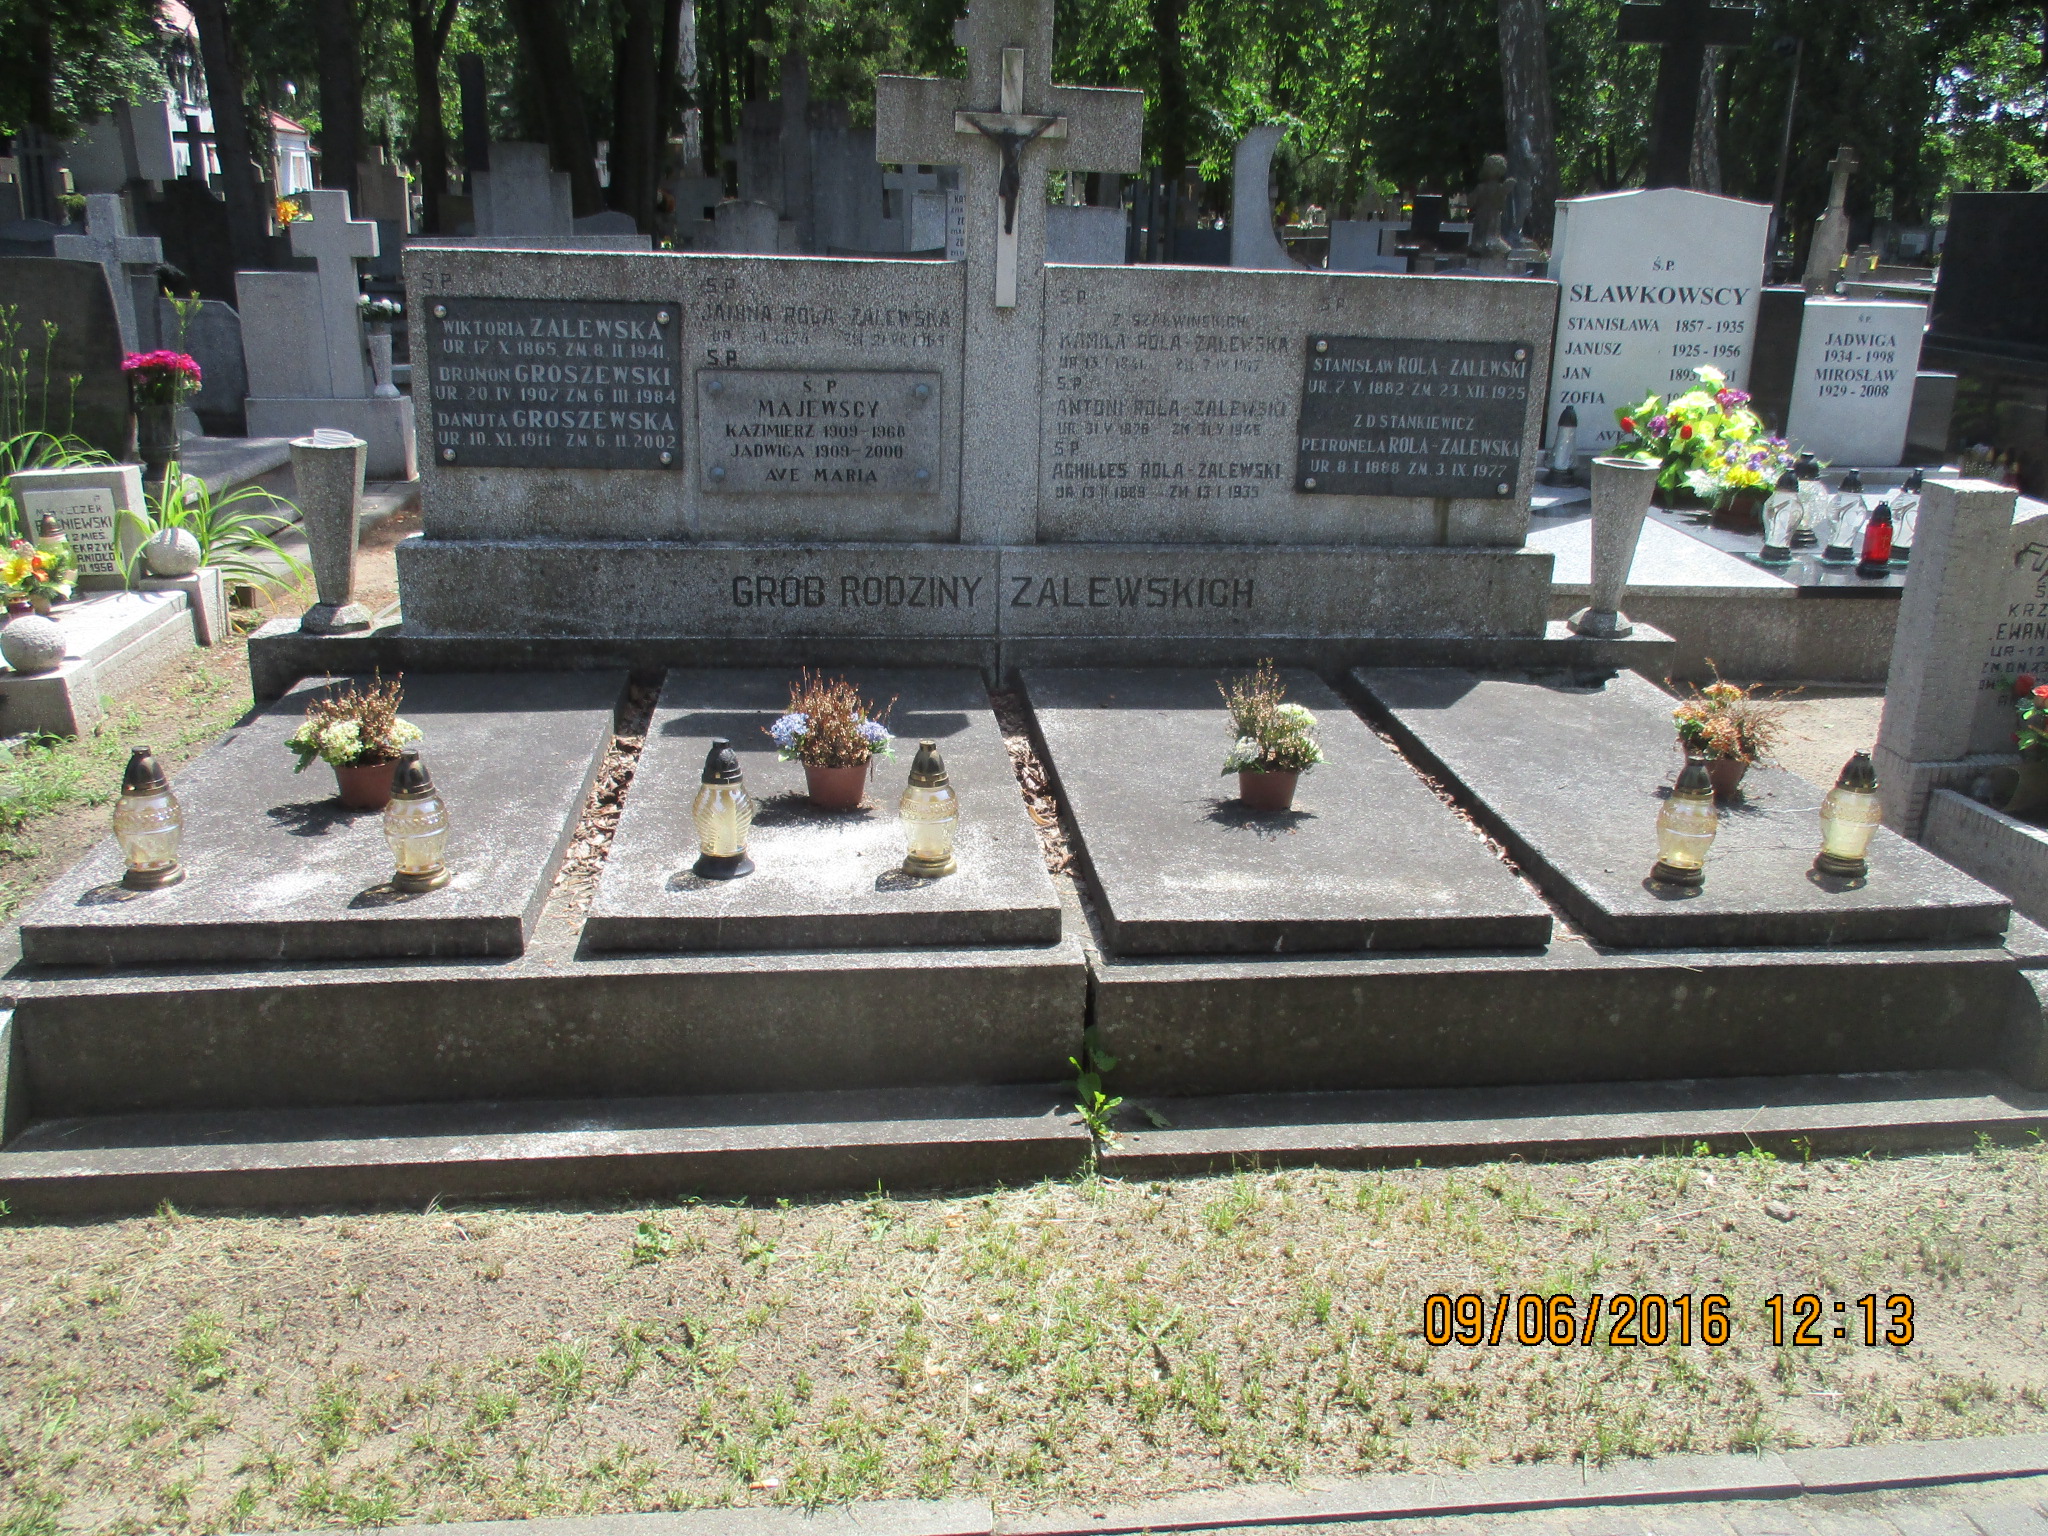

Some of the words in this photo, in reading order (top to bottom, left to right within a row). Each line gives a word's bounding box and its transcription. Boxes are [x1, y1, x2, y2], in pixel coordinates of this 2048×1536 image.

[1569, 284, 1751, 306] SŁAWKOWSCY
[442, 320, 526, 337] WIKTORIA
[530, 318, 663, 340] ZALEWSKA
[1567, 317, 1660, 332] STANISŁAWA
[1675, 319, 1704, 333] 1857
[1716, 320, 1745, 334] 1935
[1824, 333, 1896, 347] JADWIGA
[1564, 342, 1622, 356] JANUSZ
[1672, 344, 1701, 357] 1925
[1712, 345, 1741, 358] 1956
[1824, 350, 1853, 363] 1934
[1865, 351, 1895, 364] 1998
[439, 366, 511, 382] BRUNON
[1312, 357, 1394, 374] STANISŁAW
[1397, 356, 1438, 376] ROLA
[1449, 358, 1527, 379] ZALEWSKI
[1562, 366, 1592, 380] JAN
[1814, 368, 1898, 382] MIROSŁAW
[1369, 380, 1404, 396] 1882
[1492, 386, 1526, 400] 1925
[1560, 391, 1605, 404] ZOFIA
[1818, 385, 1847, 398] 1929
[1860, 385, 1889, 398] 2008
[758, 400, 880, 419] MAJEWSCY
[1056, 399, 1123, 417] ANTONI
[438, 412, 508, 428] DANUTA
[512, 410, 675, 431] GROSZEWSKA
[725, 424, 815, 438] KAZIMIERZ
[634, 435, 676, 450] 2002
[1301, 437, 1386, 453] PETRONELA
[1388, 436, 1429, 455] ROLA
[1440, 438, 1520, 458] ZALEWSKA
[730, 443, 805, 459] JADWIGA
[765, 468, 800, 482] AVE
[813, 468, 879, 483] MARIA
[1052, 463, 1128, 480] ACHILLES
[1198, 462, 1281, 479] ZALEWSKI
[1473, 464, 1507, 478] 1977
[840, 575, 983, 608] RODZINY
[1010, 576, 1255, 608] ZALEWSKICH
